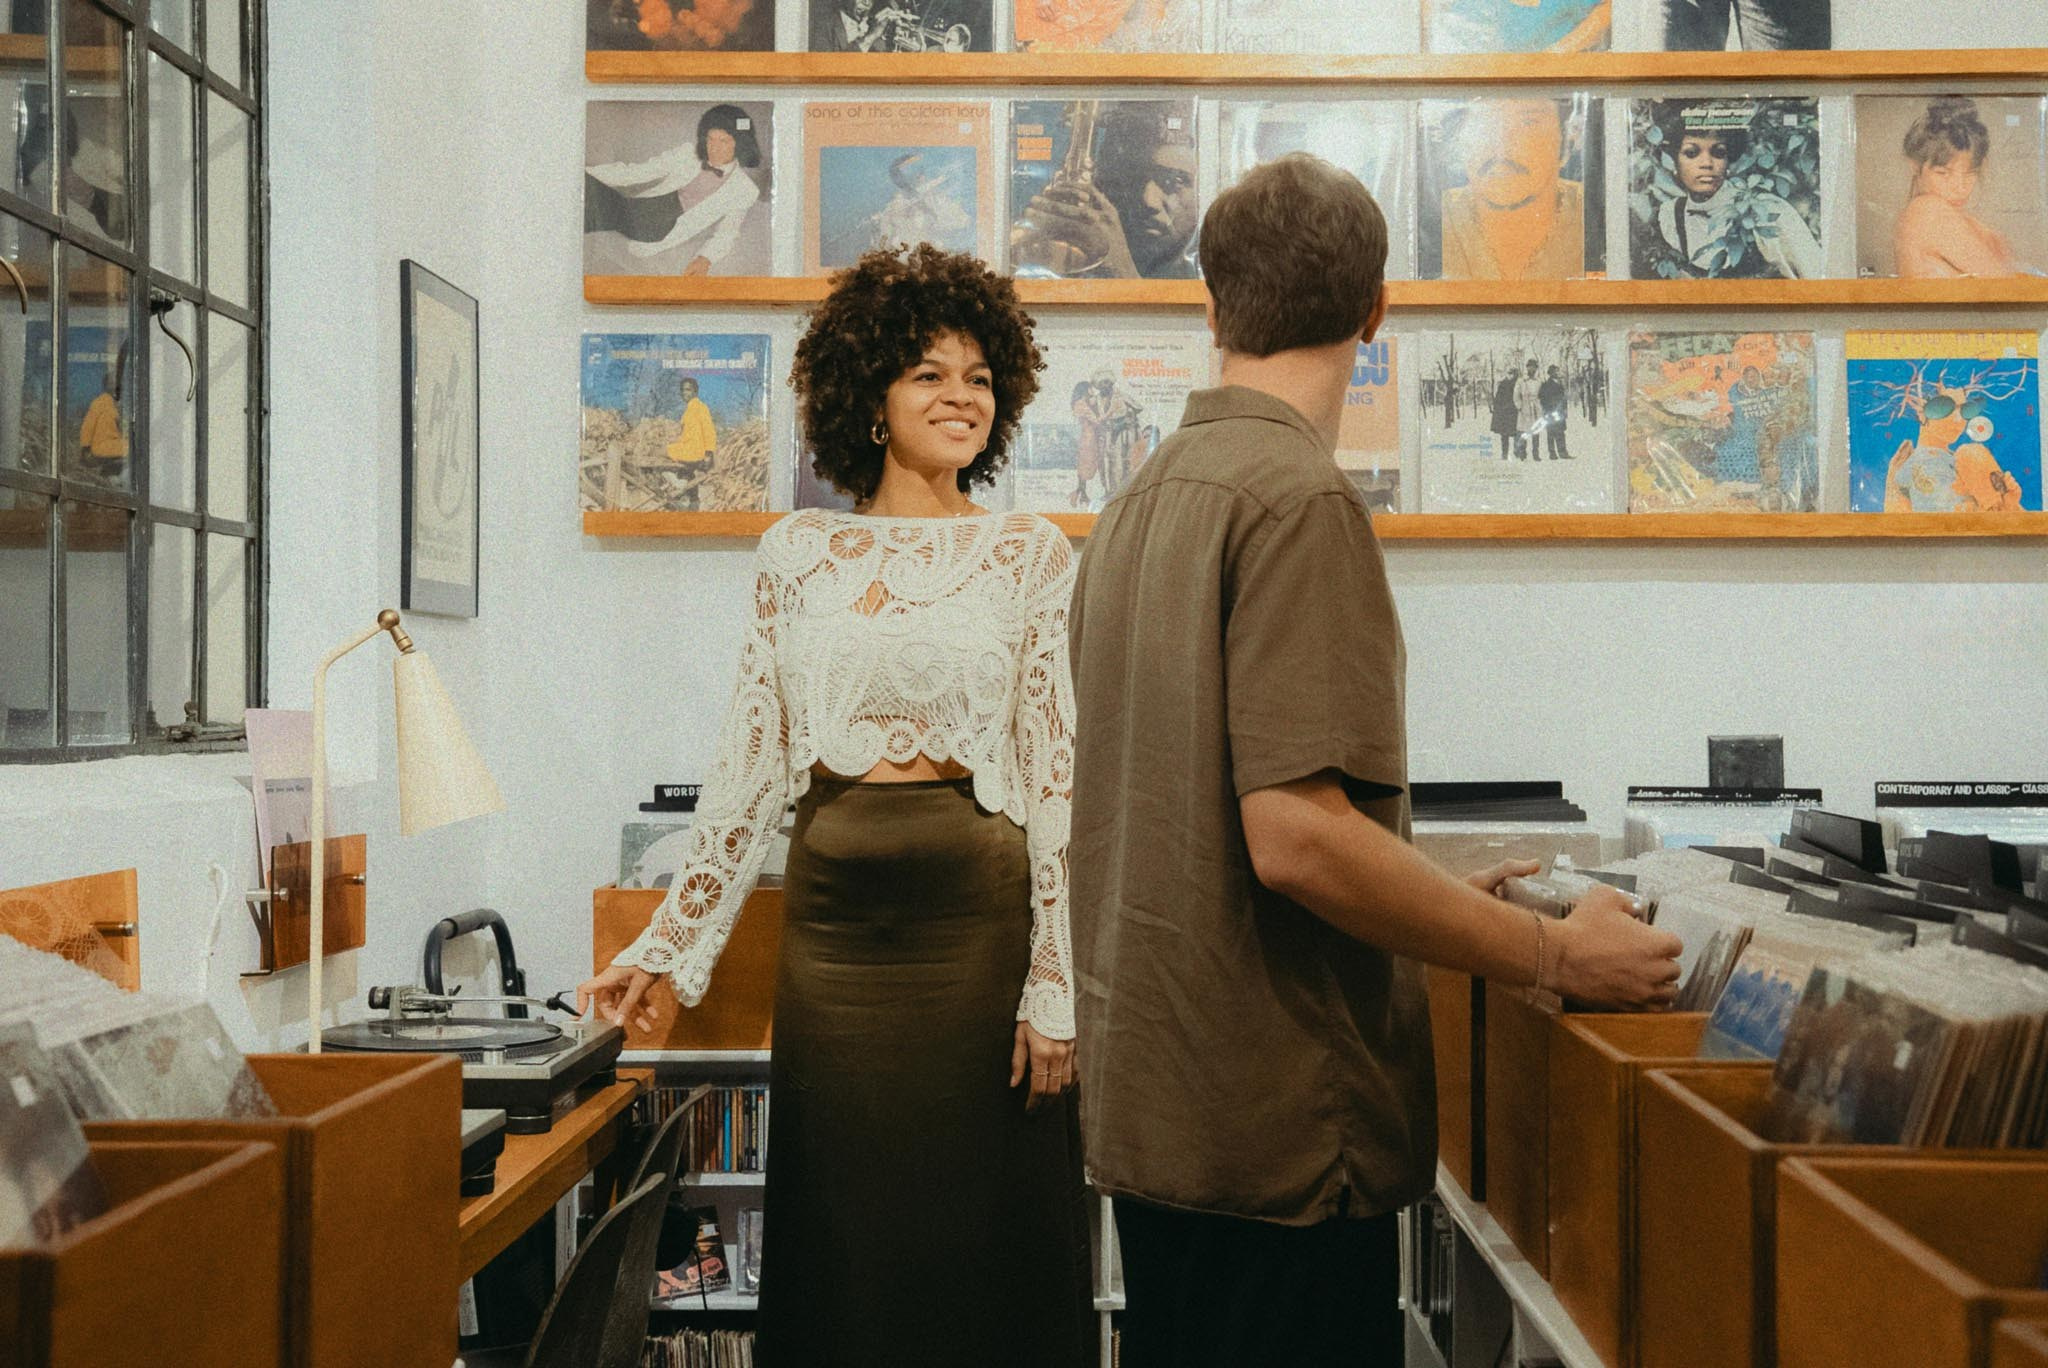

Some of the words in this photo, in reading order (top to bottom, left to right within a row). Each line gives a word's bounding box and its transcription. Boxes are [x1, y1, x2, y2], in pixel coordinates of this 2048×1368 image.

[847, 105, 863, 118] of
[868, 105, 893, 118] the
[663, 786, 702, 798] WORDS
[1877, 784, 1953, 796] CONTEMPORARY
[1954, 784, 1973, 796] AND
